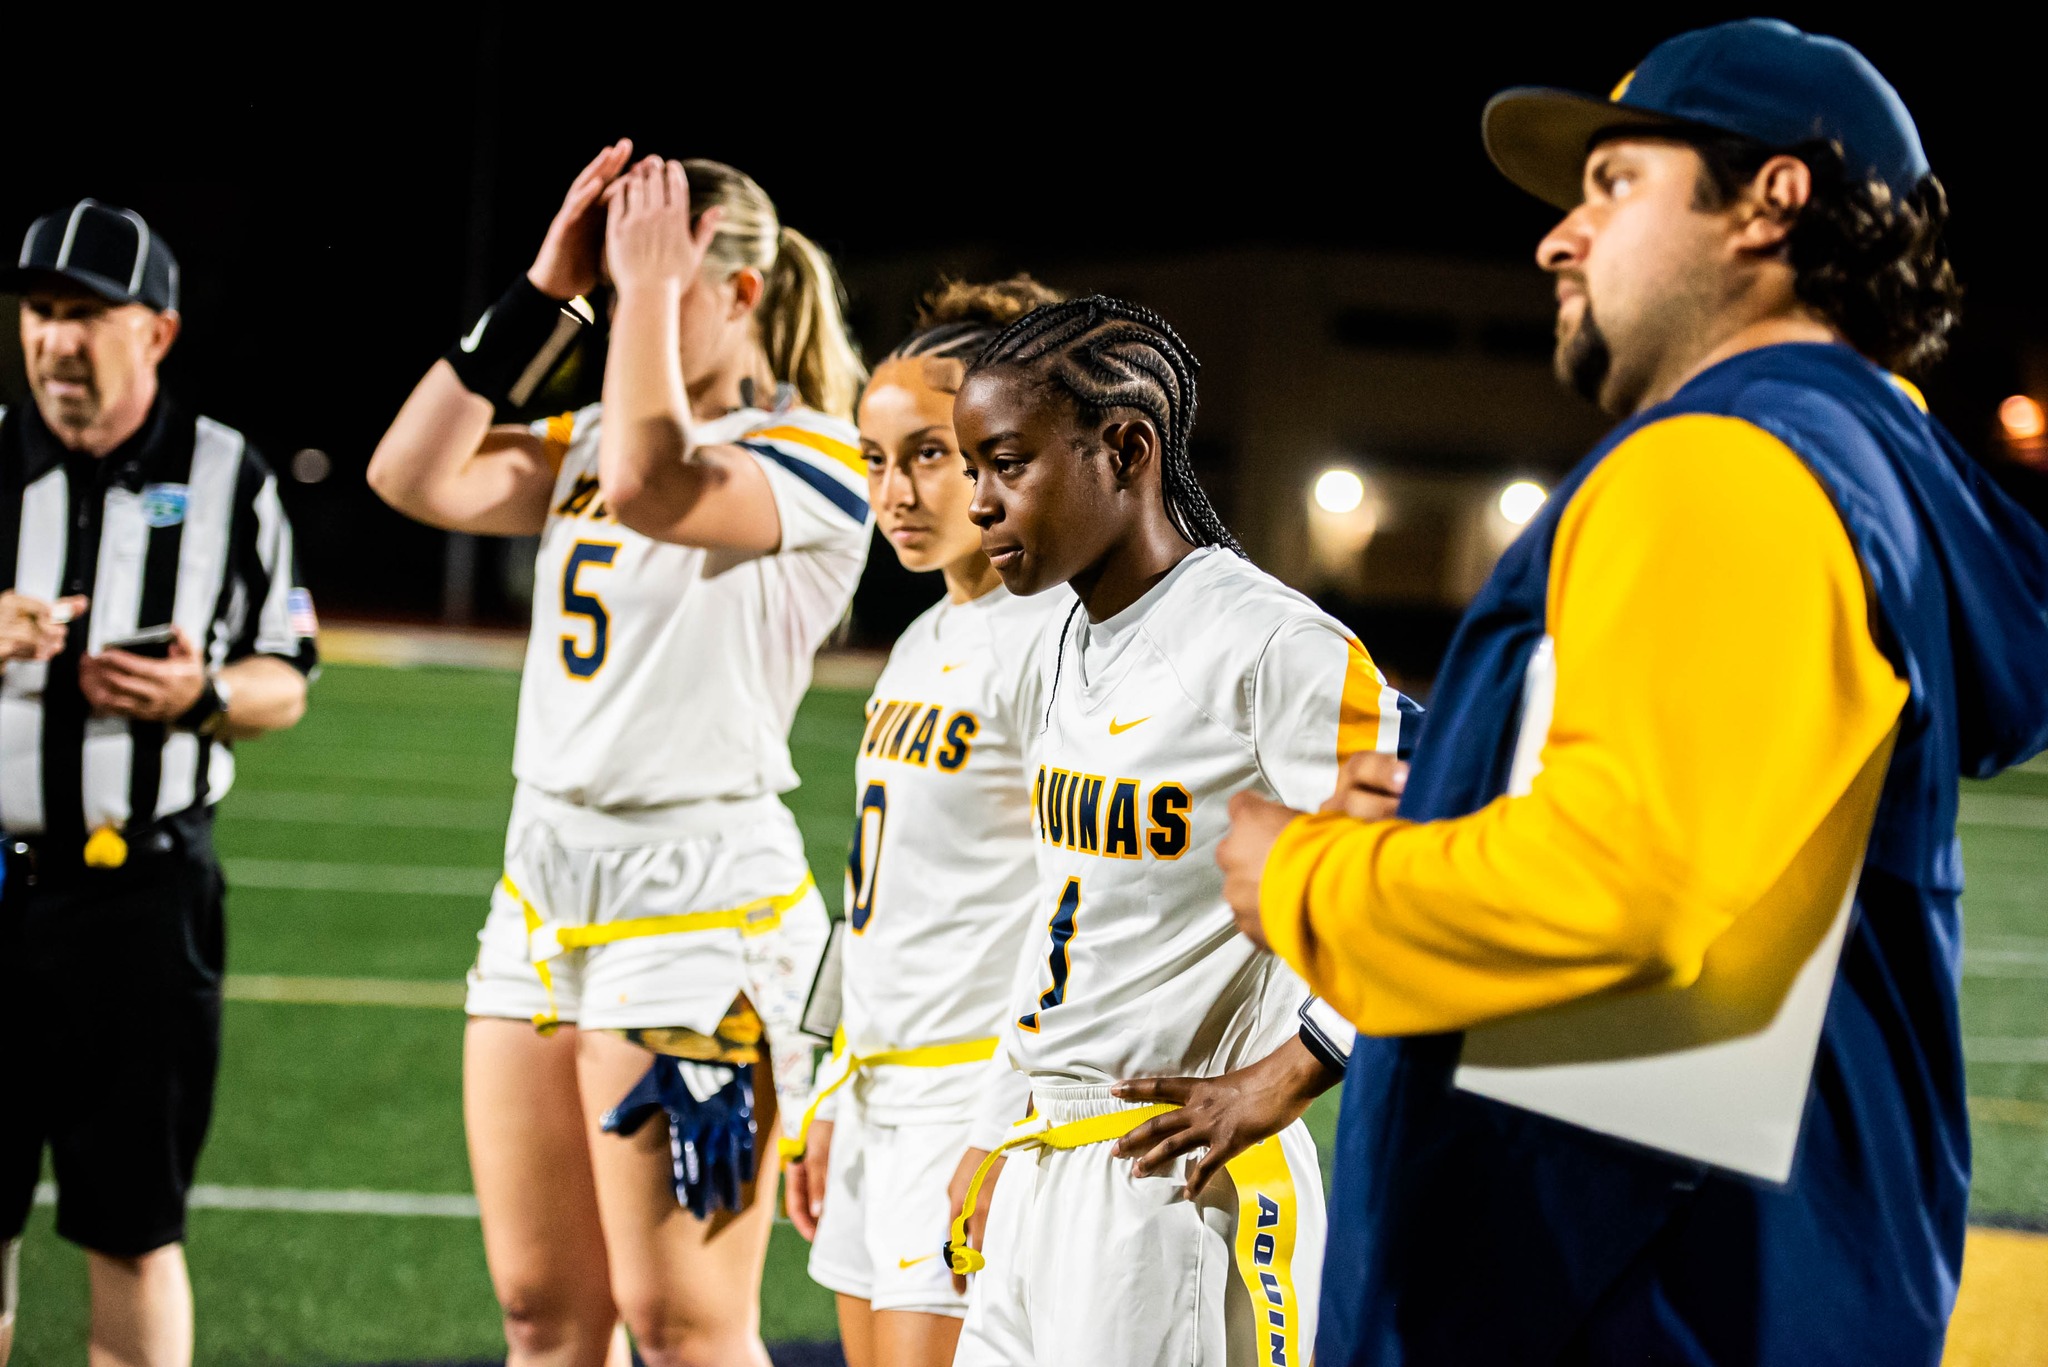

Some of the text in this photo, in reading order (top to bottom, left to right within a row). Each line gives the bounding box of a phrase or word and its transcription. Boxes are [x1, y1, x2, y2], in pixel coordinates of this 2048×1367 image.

[559, 539, 622, 681] 5
[864, 699, 981, 774] UINAS
[1017, 876, 1082, 1034] 1
[1253, 1192, 1287, 1367] AQUIN
